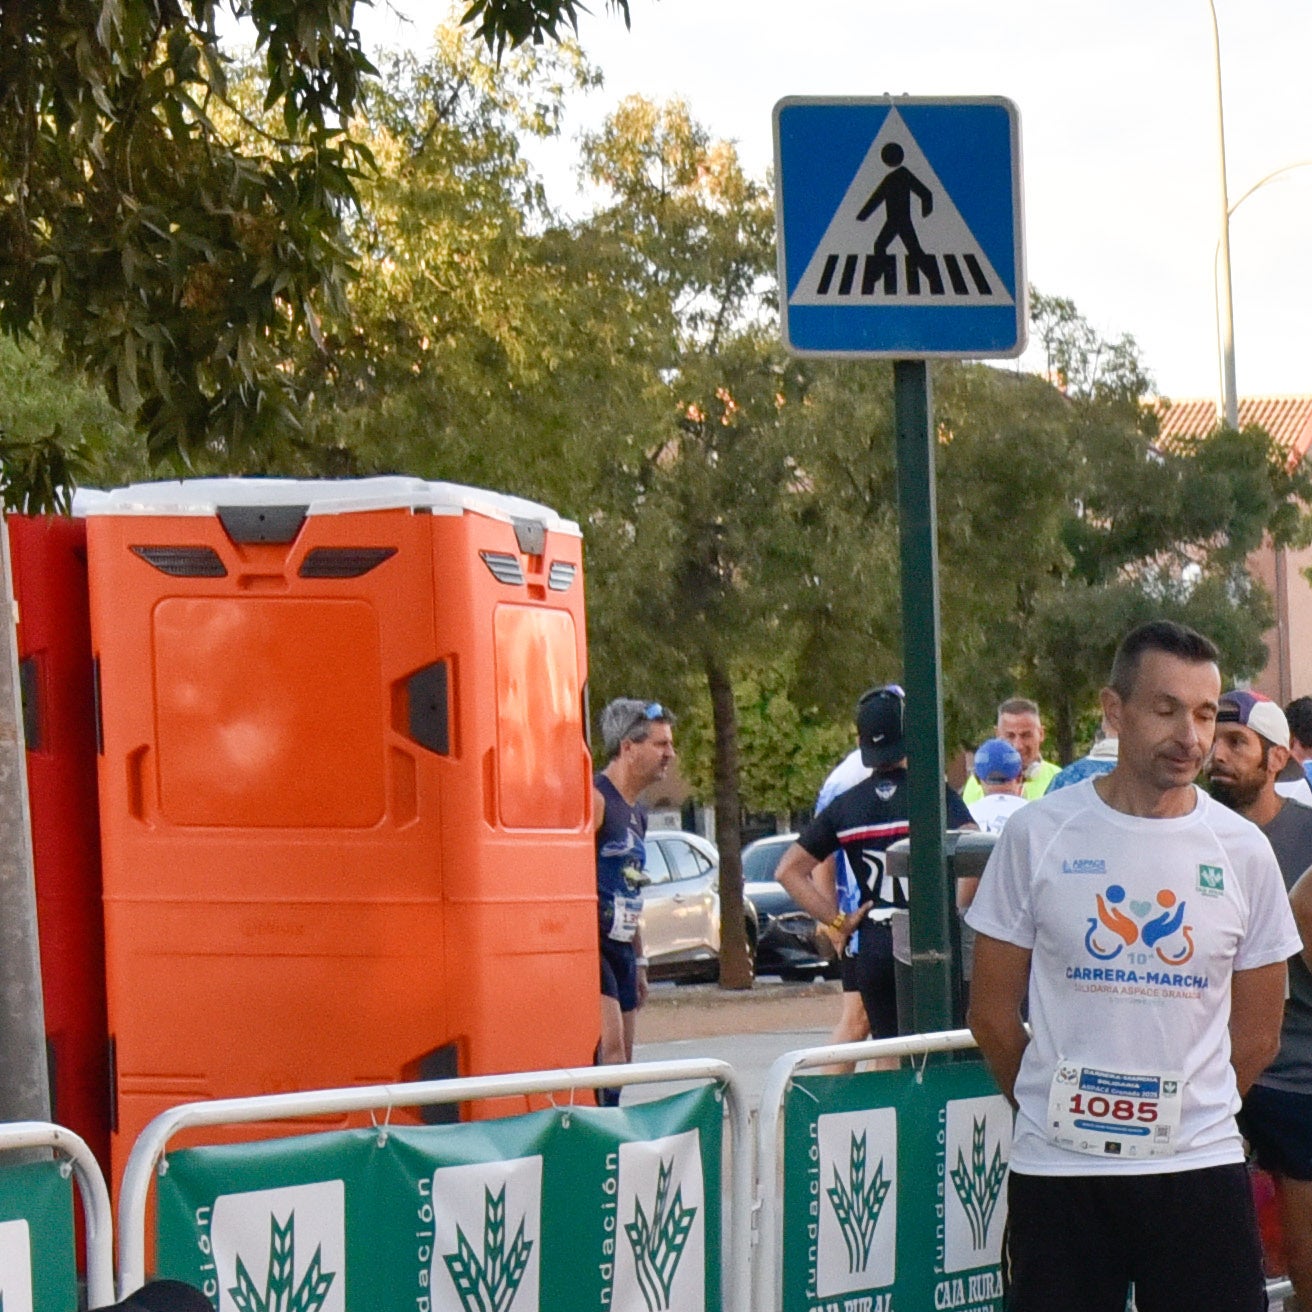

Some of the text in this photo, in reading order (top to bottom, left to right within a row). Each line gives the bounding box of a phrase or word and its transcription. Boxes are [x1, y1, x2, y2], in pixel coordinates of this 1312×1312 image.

[1069, 1093, 1159, 1123] 1085
[806, 1122, 819, 1300] fundación
[934, 1270, 1004, 1310] CAJA RURA
